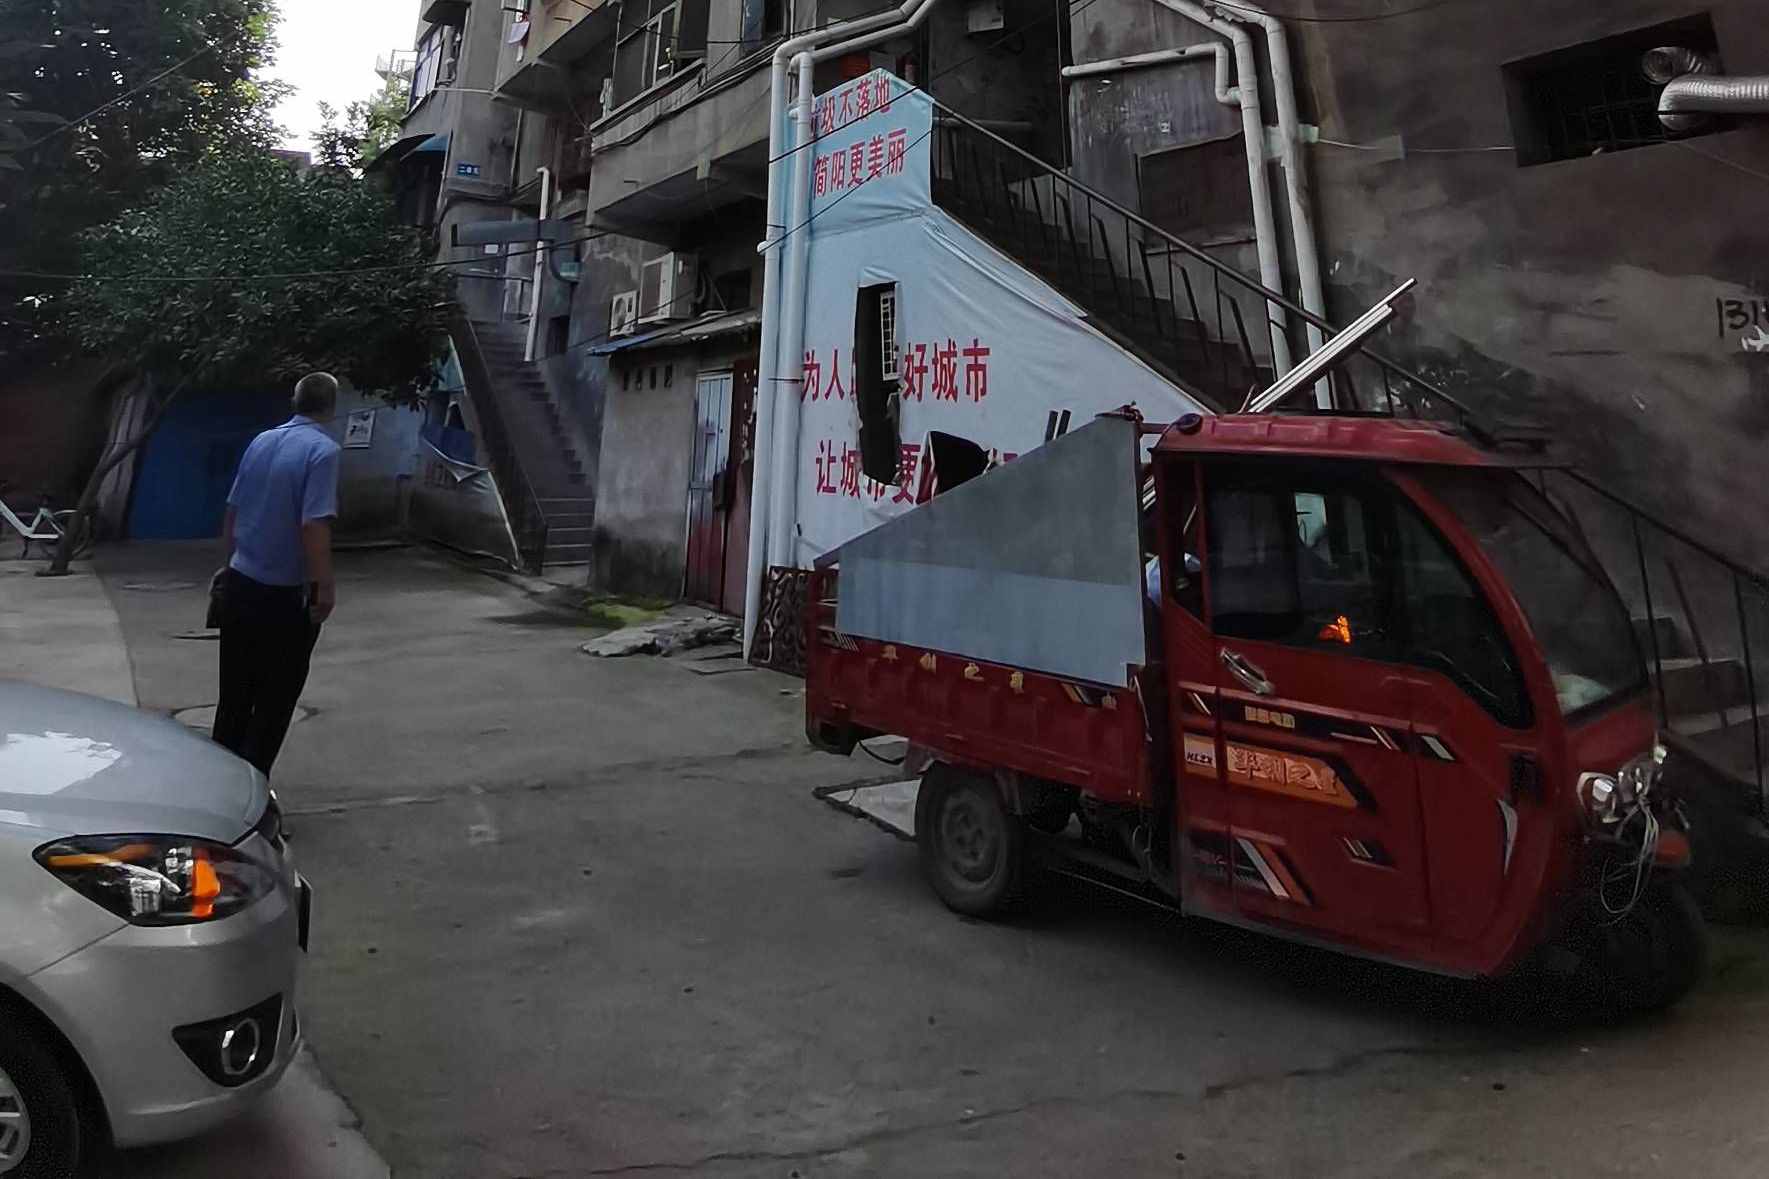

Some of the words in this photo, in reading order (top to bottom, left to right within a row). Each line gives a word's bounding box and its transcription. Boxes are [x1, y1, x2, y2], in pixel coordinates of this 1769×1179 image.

[813, 128, 907, 199] 简阳更美丽
[801, 338, 991, 404] 为人好城市
